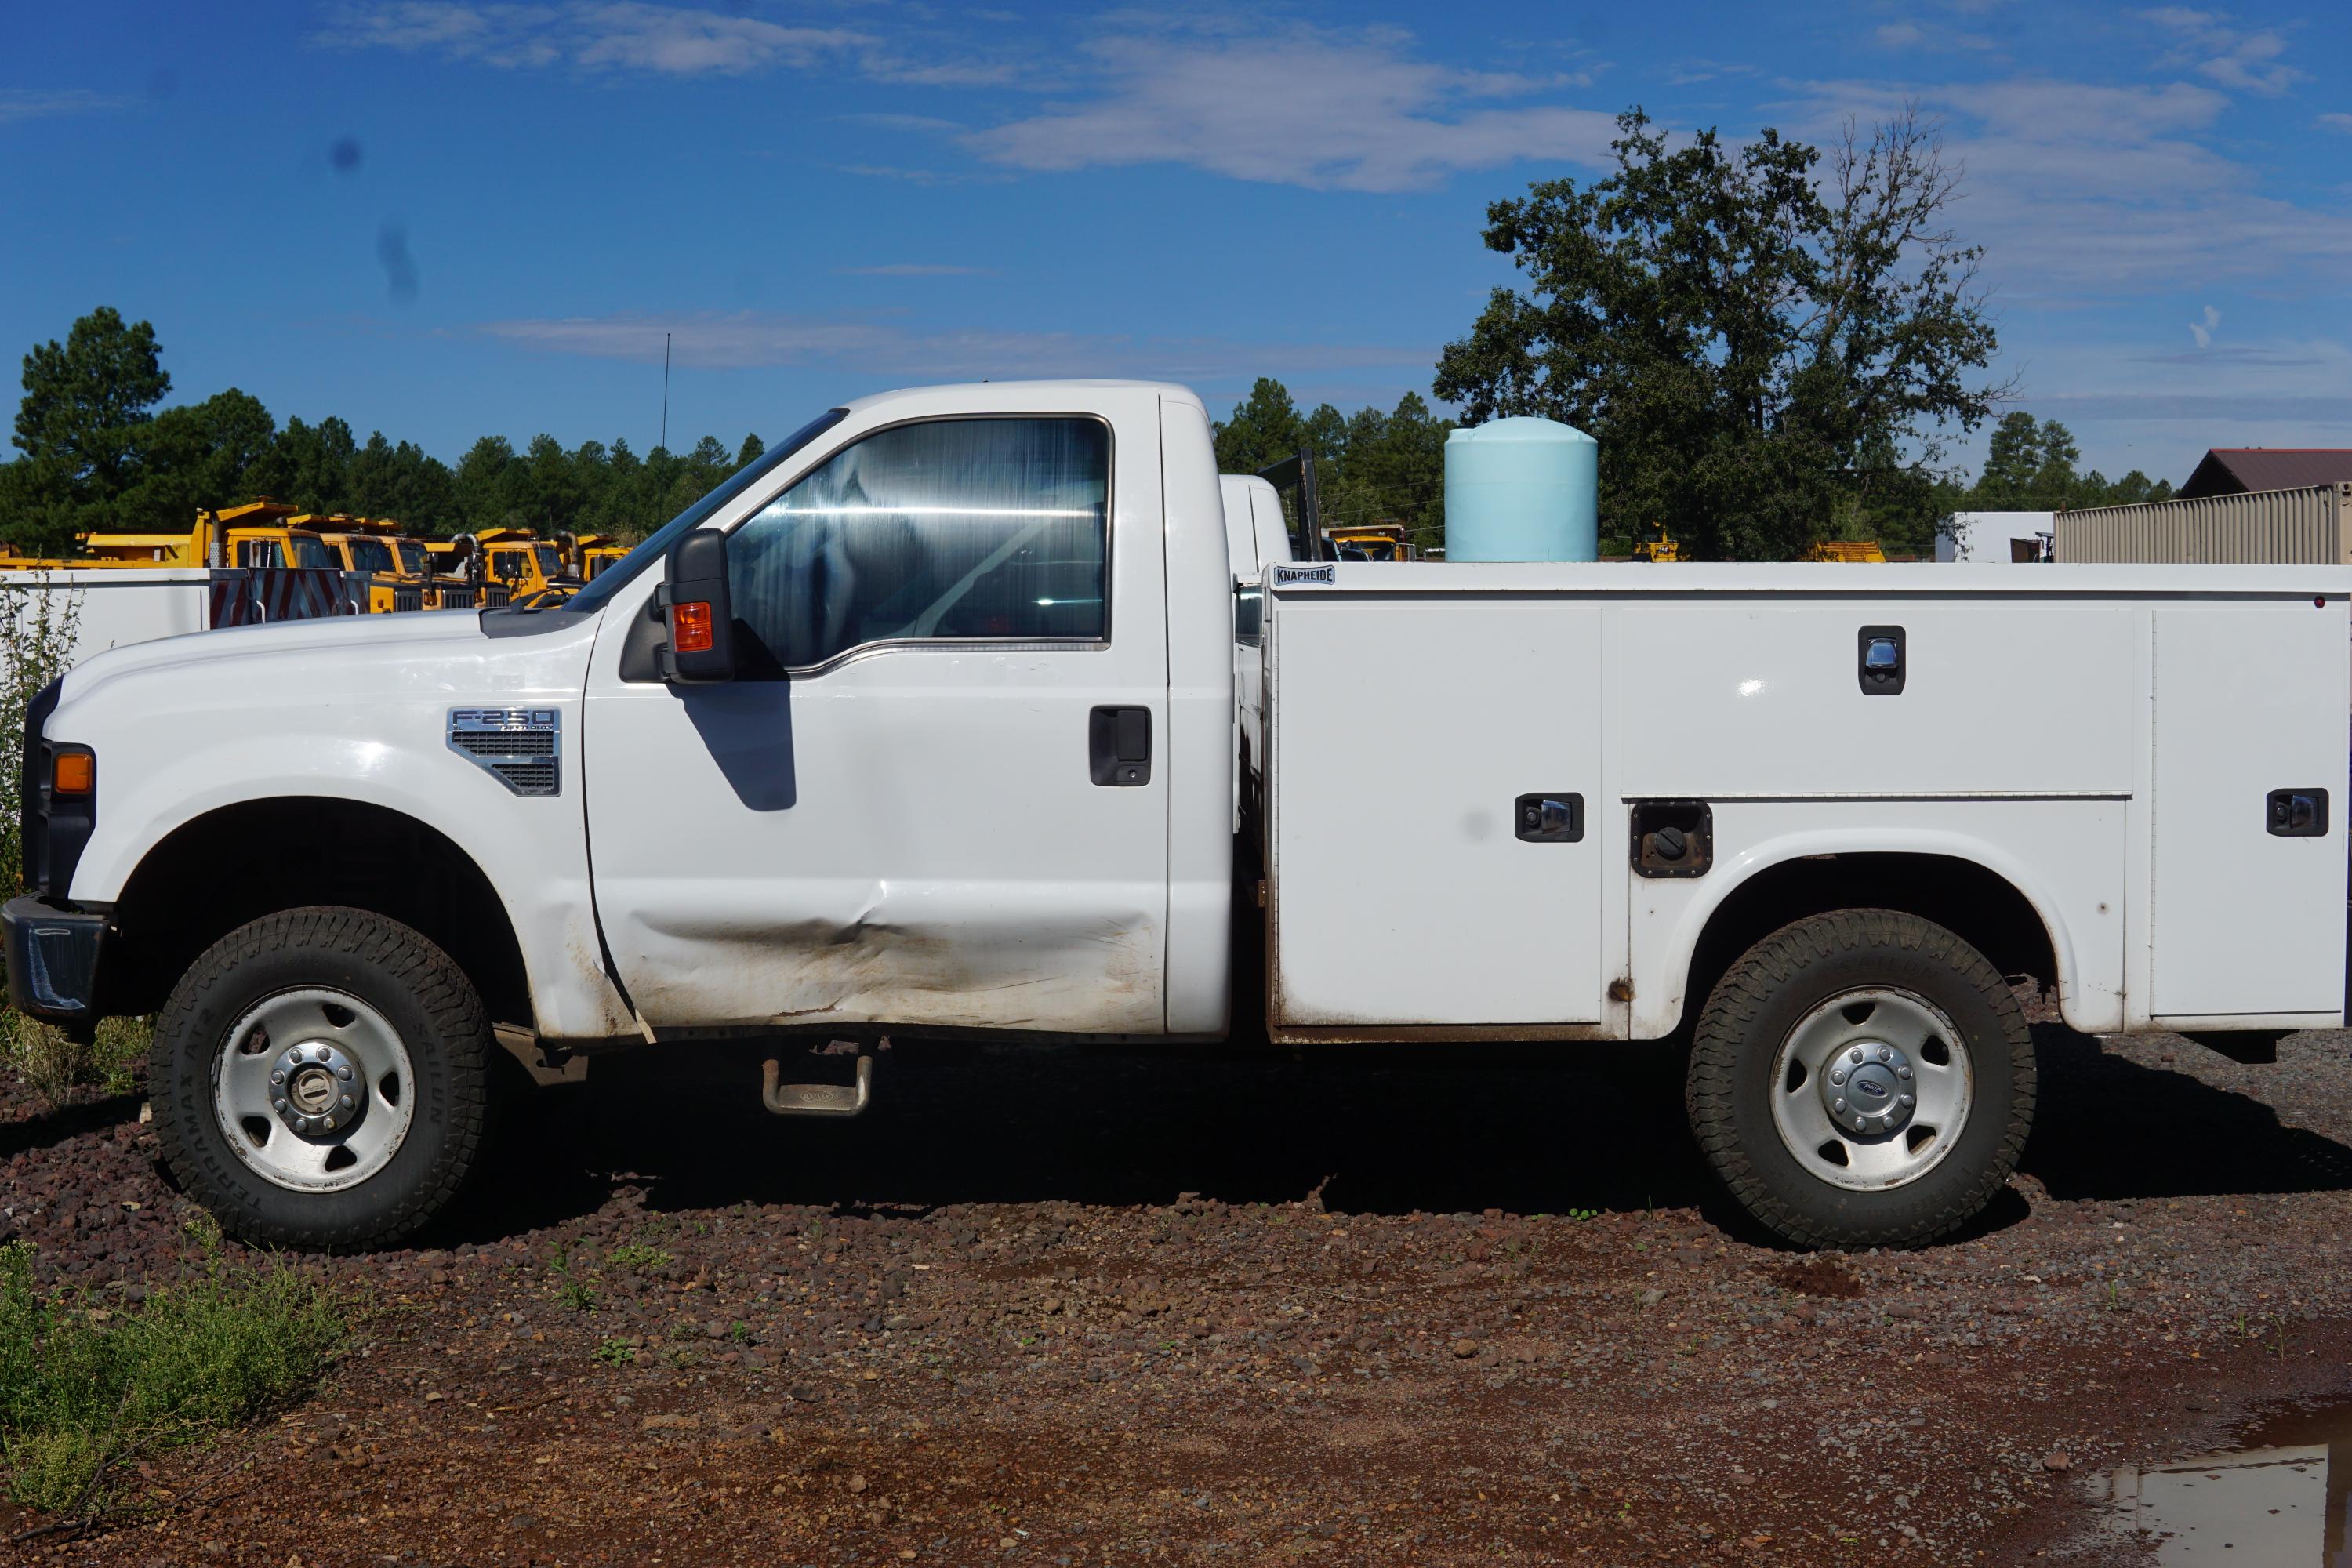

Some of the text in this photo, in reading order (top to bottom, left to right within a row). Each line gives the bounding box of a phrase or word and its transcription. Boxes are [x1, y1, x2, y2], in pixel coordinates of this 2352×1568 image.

[1277, 568, 1333, 583] KNAPHEIDE
[452, 710, 554, 725] F-250
[1838, 955, 1938, 979] SAILUN
[415, 1022, 444, 1125] SAILUN
[180, 1073, 262, 1211] TERRAMAX
